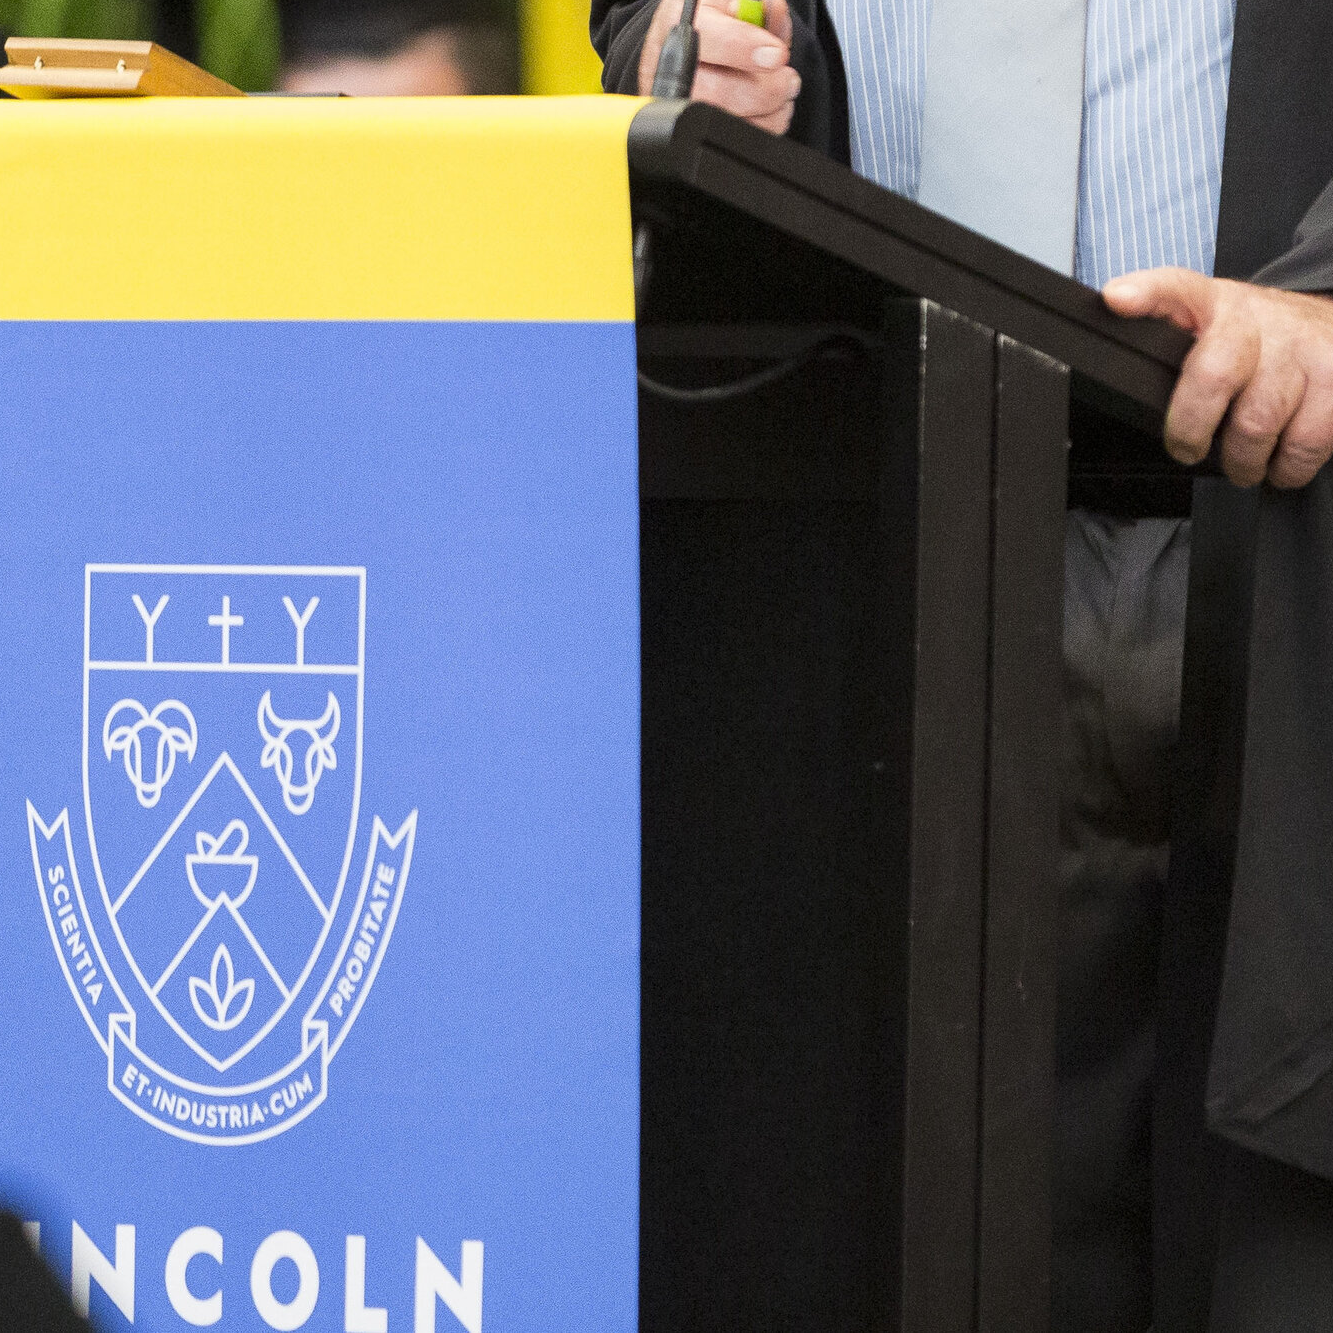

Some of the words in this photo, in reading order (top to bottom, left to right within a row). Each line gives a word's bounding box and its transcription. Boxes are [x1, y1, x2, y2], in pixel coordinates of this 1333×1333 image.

[47, 864, 104, 1006] SCIENTIA
[328, 862, 396, 1017] PROBITATE
[22, 1219, 485, 1333] NCOLN
